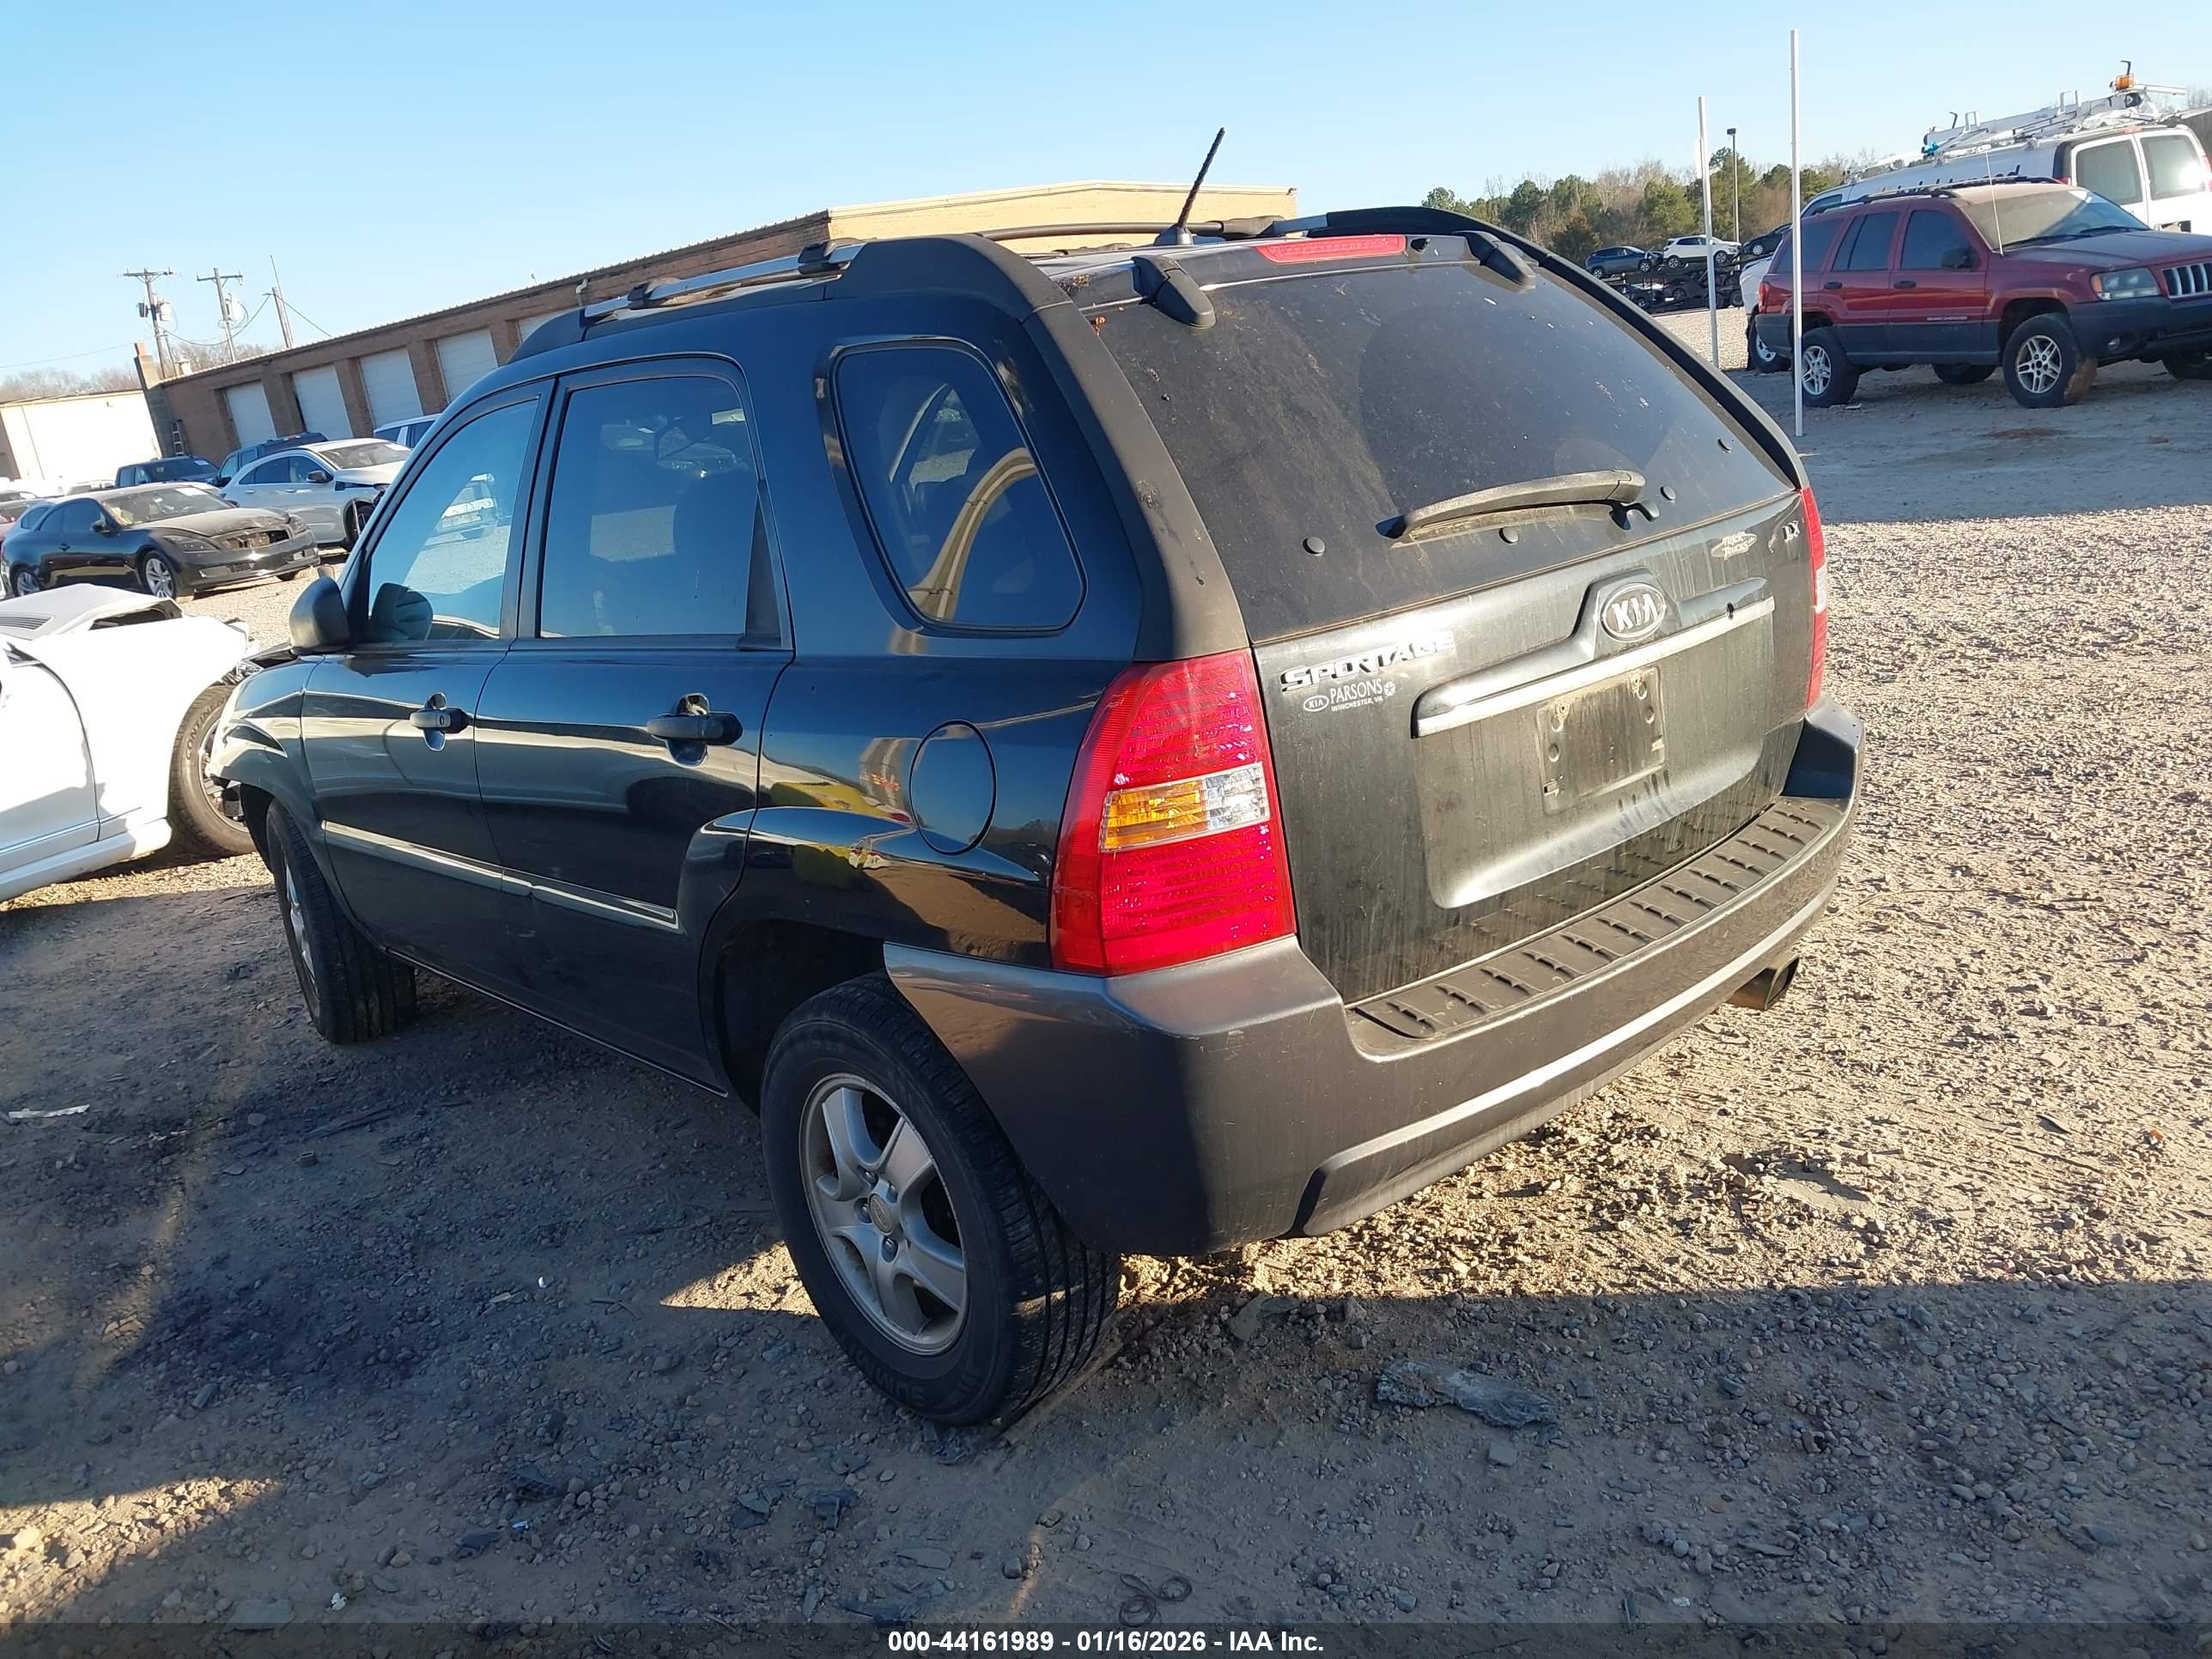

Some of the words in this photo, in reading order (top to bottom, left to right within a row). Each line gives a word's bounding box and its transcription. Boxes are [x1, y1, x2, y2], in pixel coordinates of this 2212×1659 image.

[1611, 593, 1658, 631] KIA
[1279, 631, 1455, 693] SPORTAGE
[1329, 678, 1383, 704] PARSONS
[1374, 696, 1384, 706] VA
